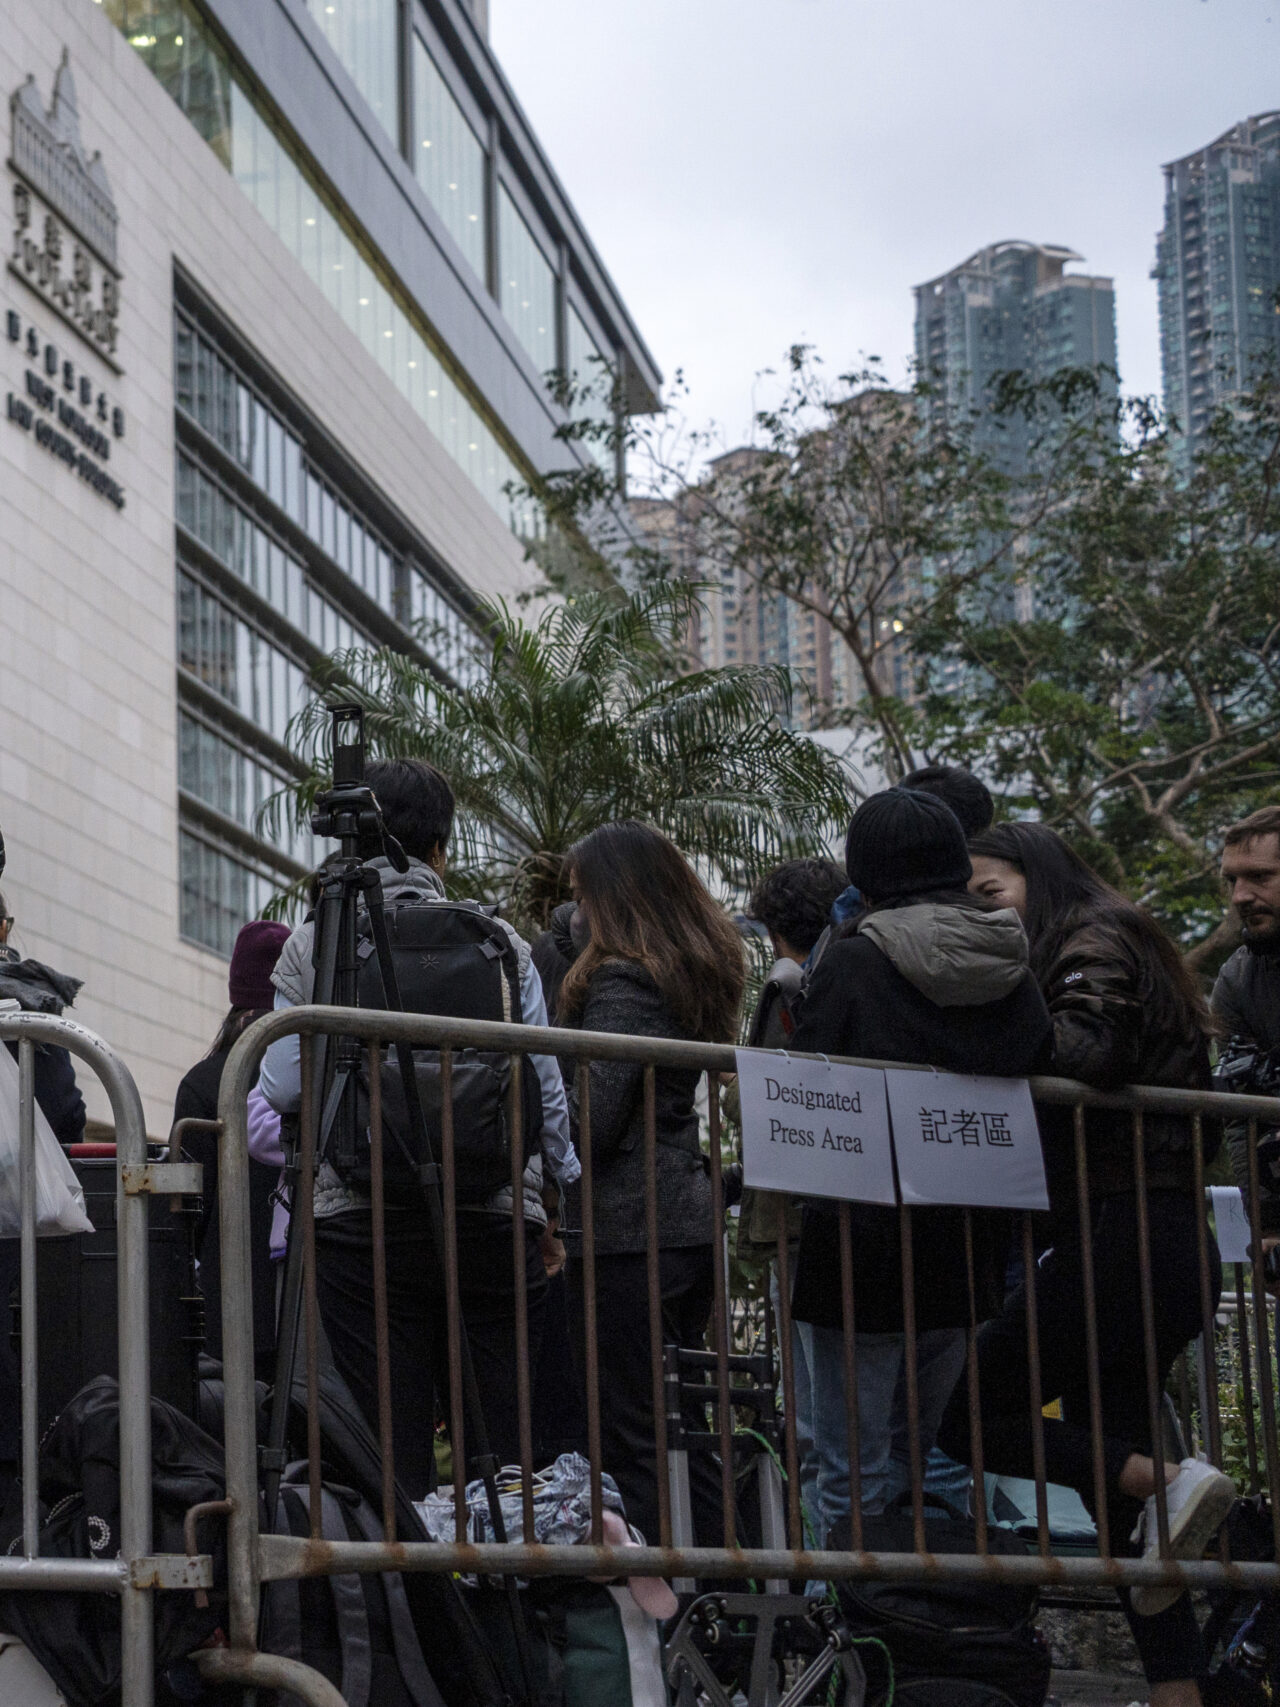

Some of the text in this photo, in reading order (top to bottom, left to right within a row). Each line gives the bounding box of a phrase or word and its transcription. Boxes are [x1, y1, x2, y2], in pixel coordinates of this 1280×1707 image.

[1064, 971, 1083, 983] alo
[764, 1077, 862, 1114] Designated
[769, 1119, 864, 1154] Press Area
[918, 1107, 1014, 1148] 記者區
